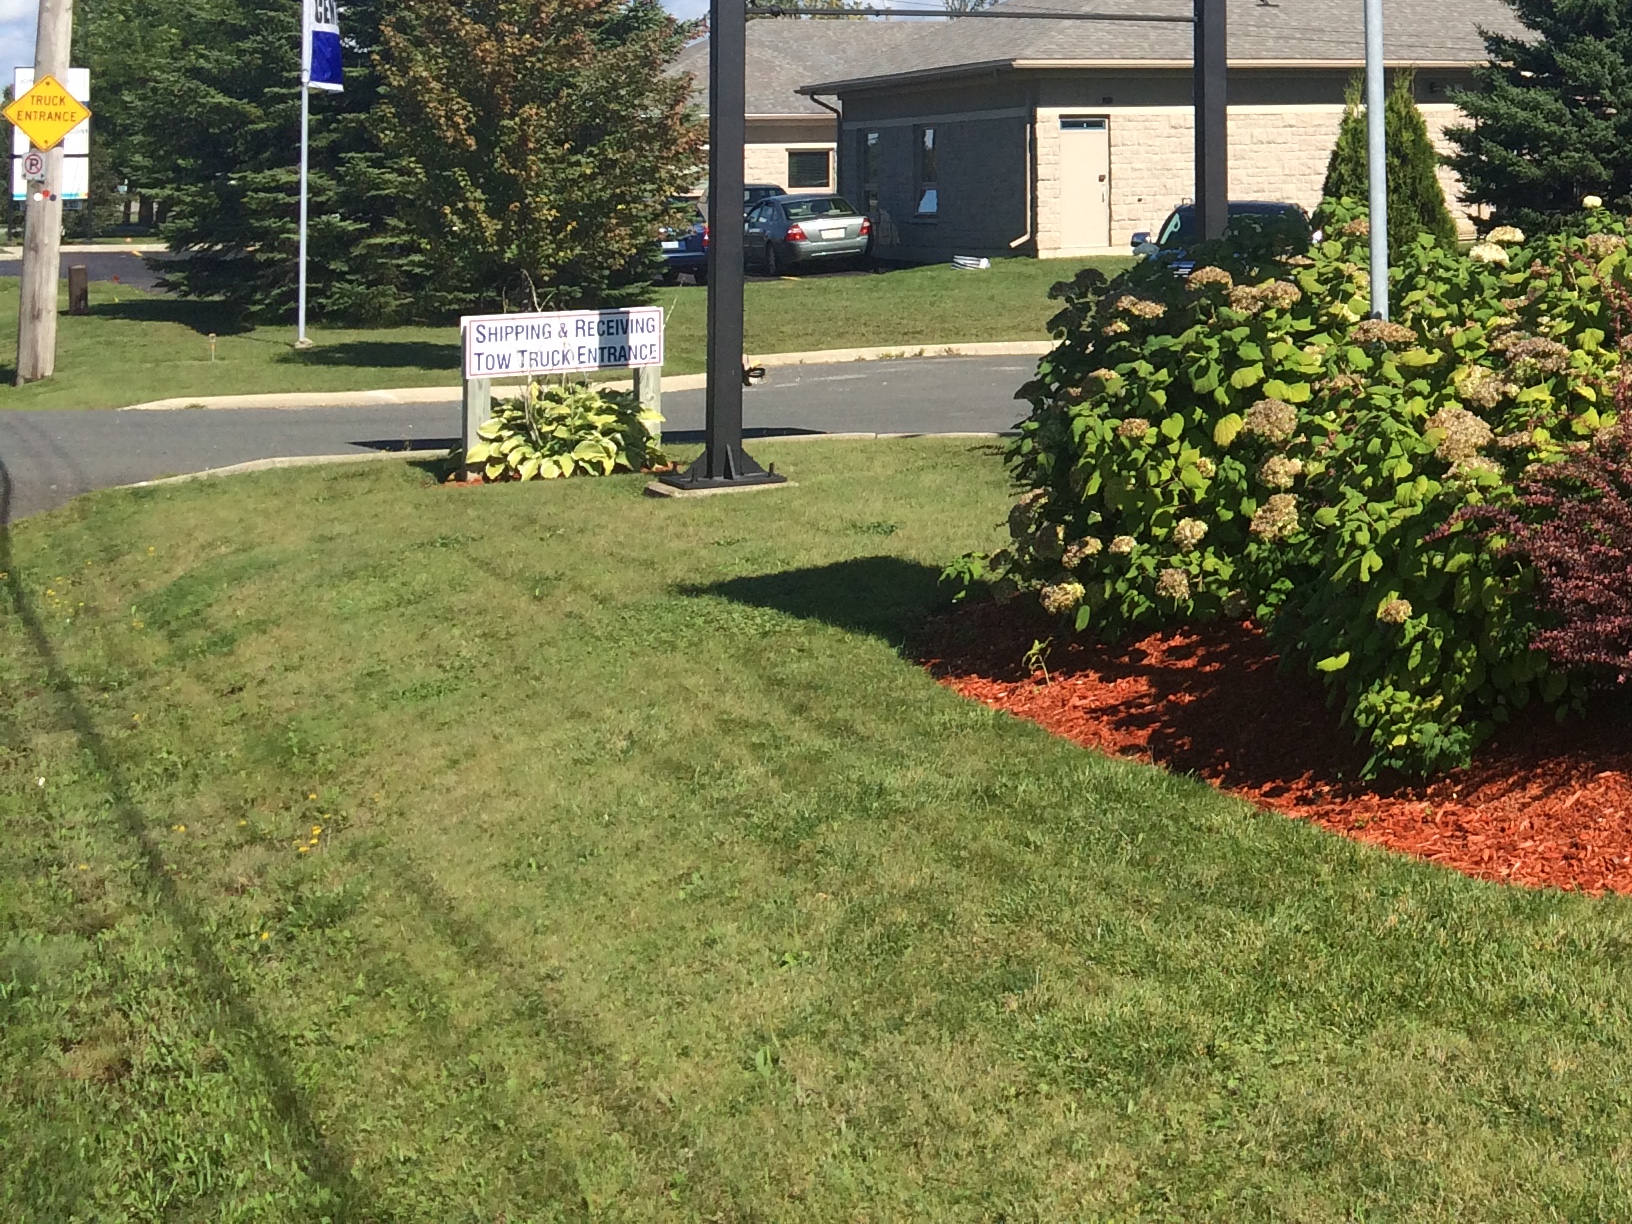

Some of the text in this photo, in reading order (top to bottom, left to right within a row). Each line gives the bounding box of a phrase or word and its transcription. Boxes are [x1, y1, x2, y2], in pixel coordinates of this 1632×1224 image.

[30, 95, 66, 107] TRUCK
[17, 110, 77, 122] ENTRANCE
[558, 323, 568, 339] &
